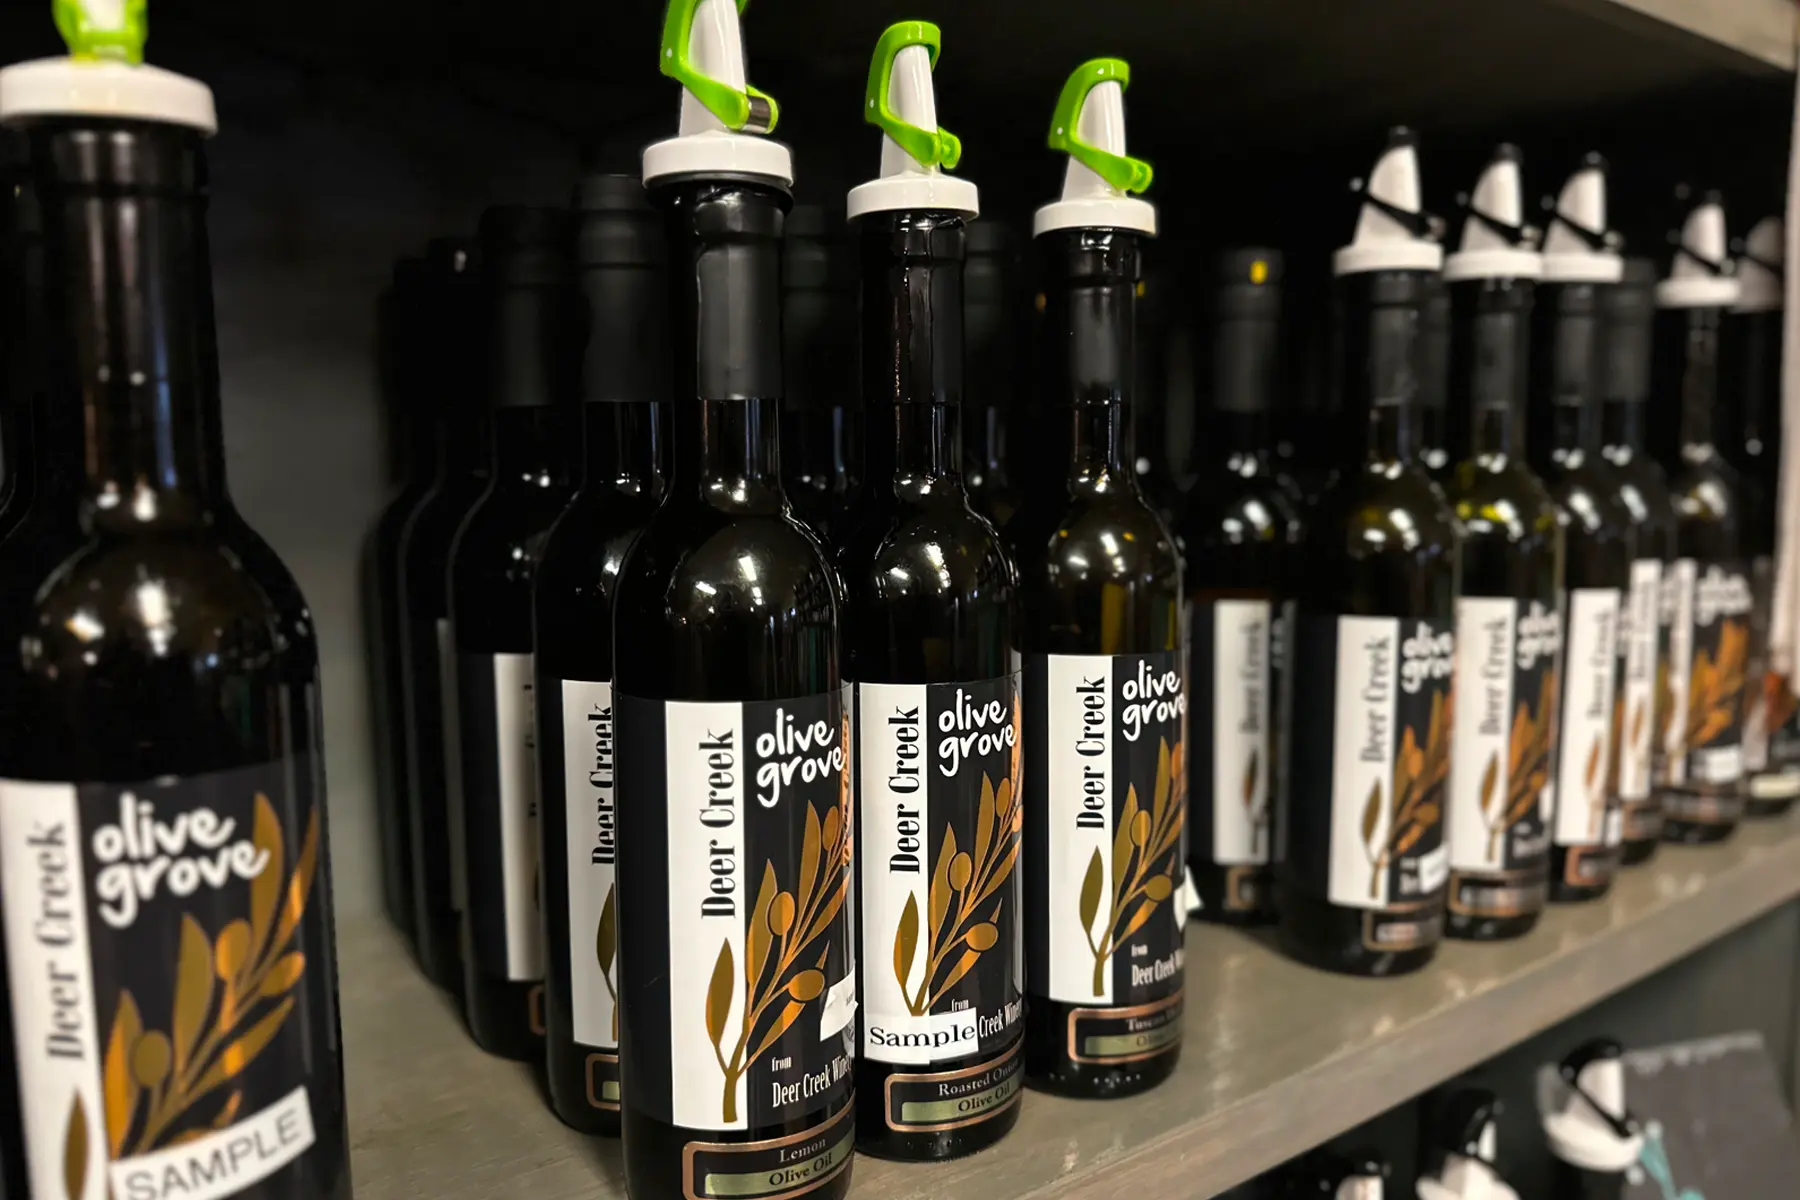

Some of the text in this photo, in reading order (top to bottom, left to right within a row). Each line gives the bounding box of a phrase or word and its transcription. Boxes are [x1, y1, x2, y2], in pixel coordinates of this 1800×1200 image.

[1122, 659, 1181, 701] olive
[1360, 636, 1391, 762] Deer Creek
[756, 708, 835, 758] olive
[938, 688, 1007, 733] olive
[1122, 692, 1187, 742] grove
[938, 723, 1018, 777] grove
[1075, 676, 1106, 830] Deer Creek
[588, 703, 615, 864] Deer Creek
[757, 745, 846, 809] grove
[888, 705, 921, 874] Deer Creek
[92, 791, 237, 860] olive
[698, 728, 736, 920] Deer Creek
[97, 839, 270, 929] grove
[27, 822, 85, 1061] Deer Creek
[1131, 964, 1154, 987] Deer
[870, 1023, 976, 1048] Sample
[979, 1008, 1004, 1039] Creek
[771, 1056, 792, 1072] from
[772, 1081, 802, 1108] Deer
[803, 1064, 831, 1099] Creek
[938, 1074, 991, 1097] Roasted
[958, 1082, 1010, 1113] Olive Oil
[124, 1107, 301, 1200] SAMPLE
[769, 1152, 833, 1186] Olive Oil
[780, 1139, 826, 1163] Lemon
